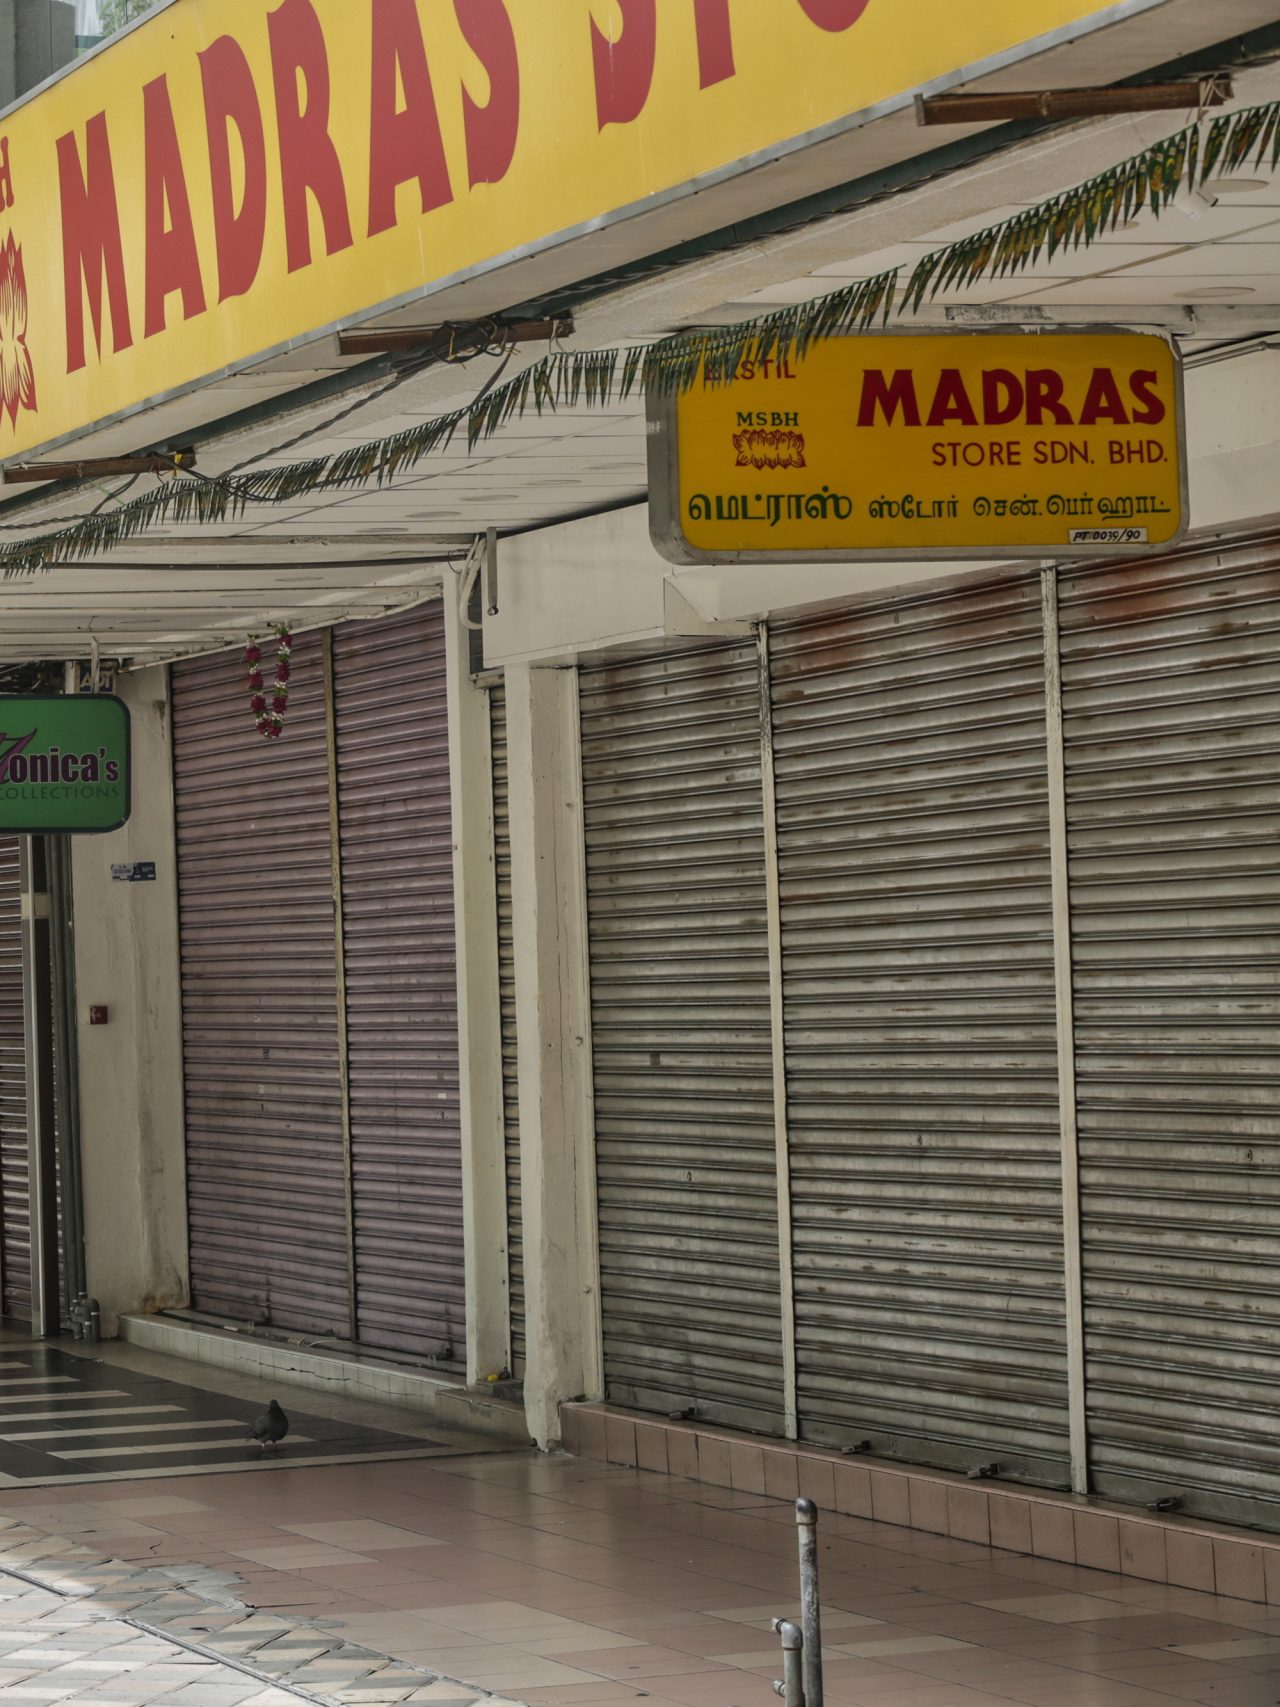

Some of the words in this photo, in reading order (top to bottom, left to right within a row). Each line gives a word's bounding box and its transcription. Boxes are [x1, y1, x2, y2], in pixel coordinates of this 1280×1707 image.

[55, 0, 520, 374] MADRAS
[856, 368, 1166, 427] MADRAS
[736, 412, 799, 426] MSBH
[932, 442, 1021, 466] STORE
[1033, 441, 1095, 464] SDN.
[1109, 440, 1168, 463] BHD.
[1073, 531, 1090, 542] PT
